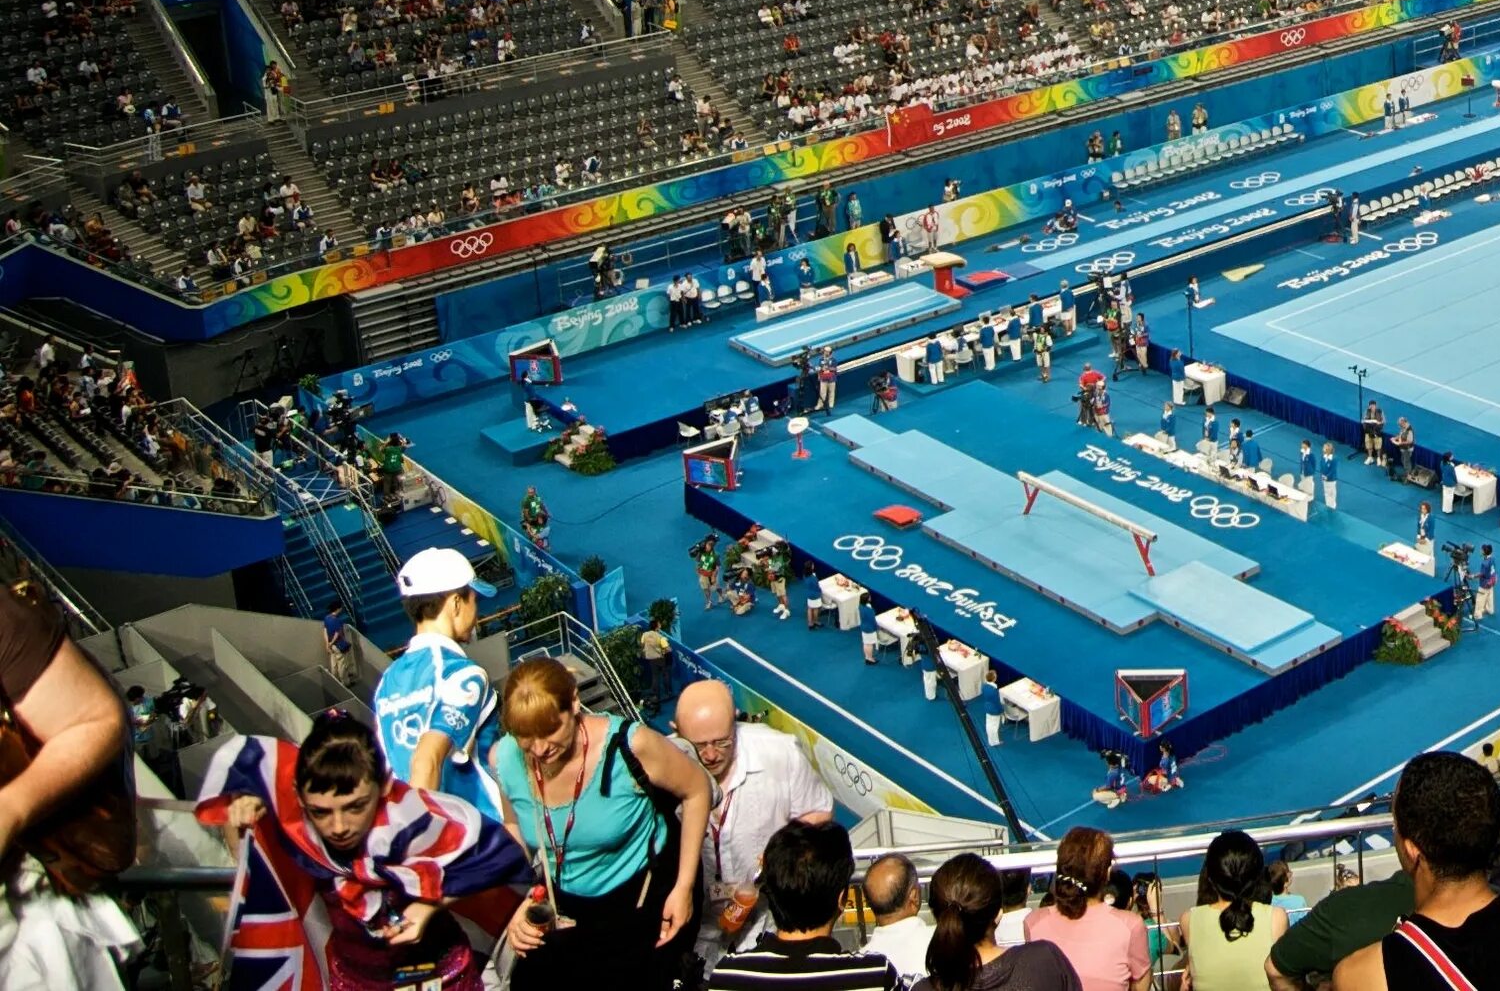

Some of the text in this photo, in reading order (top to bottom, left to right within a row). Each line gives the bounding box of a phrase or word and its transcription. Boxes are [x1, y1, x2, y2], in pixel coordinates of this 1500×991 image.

[946, 114, 972, 130] 2008
[1095, 191, 1221, 229] Beijing 2008
[1147, 208, 1277, 247] Beijing 2008
[1276, 250, 1390, 289] Beijing 2008
[551, 297, 638, 331] Beijing 2008
[372, 366, 401, 378] Beijing
[1077, 444, 1193, 502] Beijing 2008
[895, 564, 1017, 637] Beijing 2008
